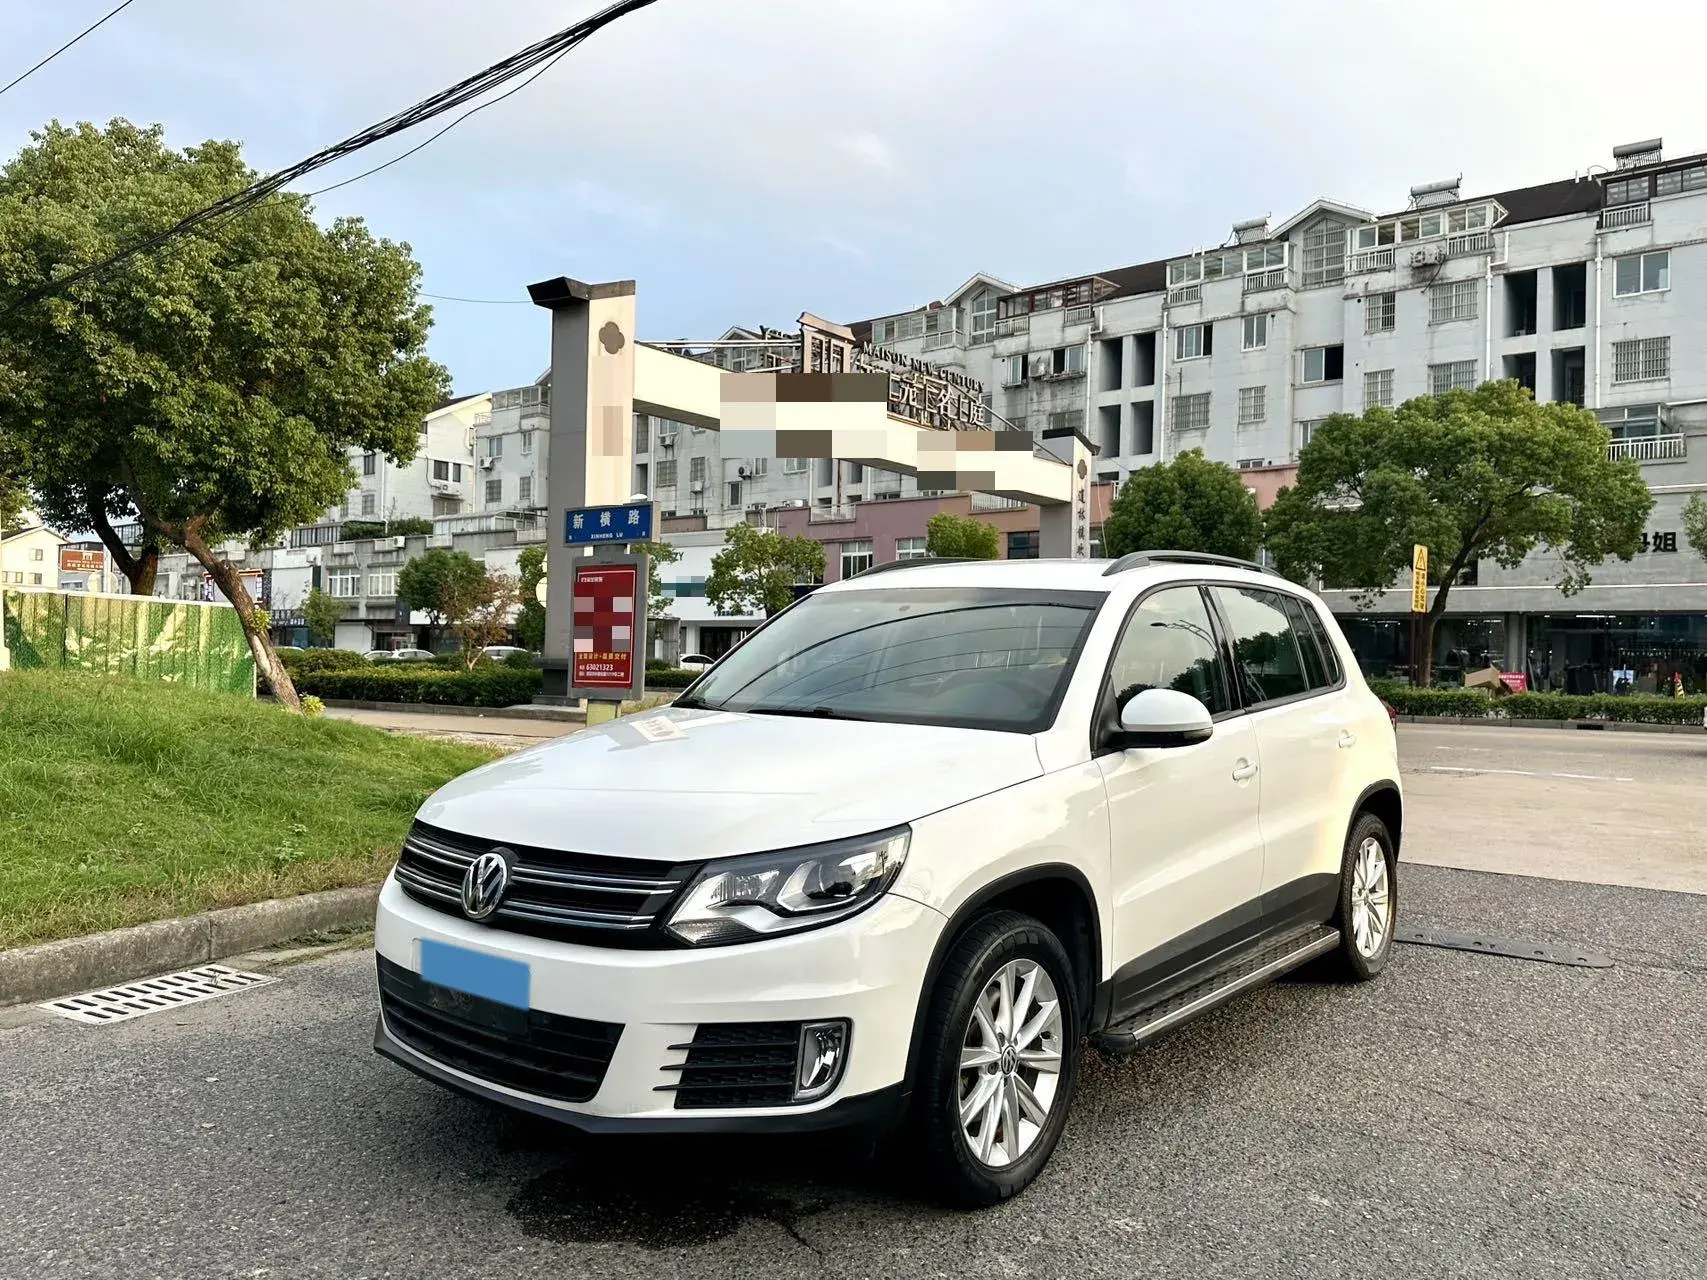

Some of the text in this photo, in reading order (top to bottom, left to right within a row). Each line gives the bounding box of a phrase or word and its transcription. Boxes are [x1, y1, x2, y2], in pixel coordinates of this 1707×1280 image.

[863, 341, 907, 367] MAISON
[939, 369, 984, 393] CENTURY
[573, 509, 640, 529] 新横路
[586, 663, 614, 671] 63021323
